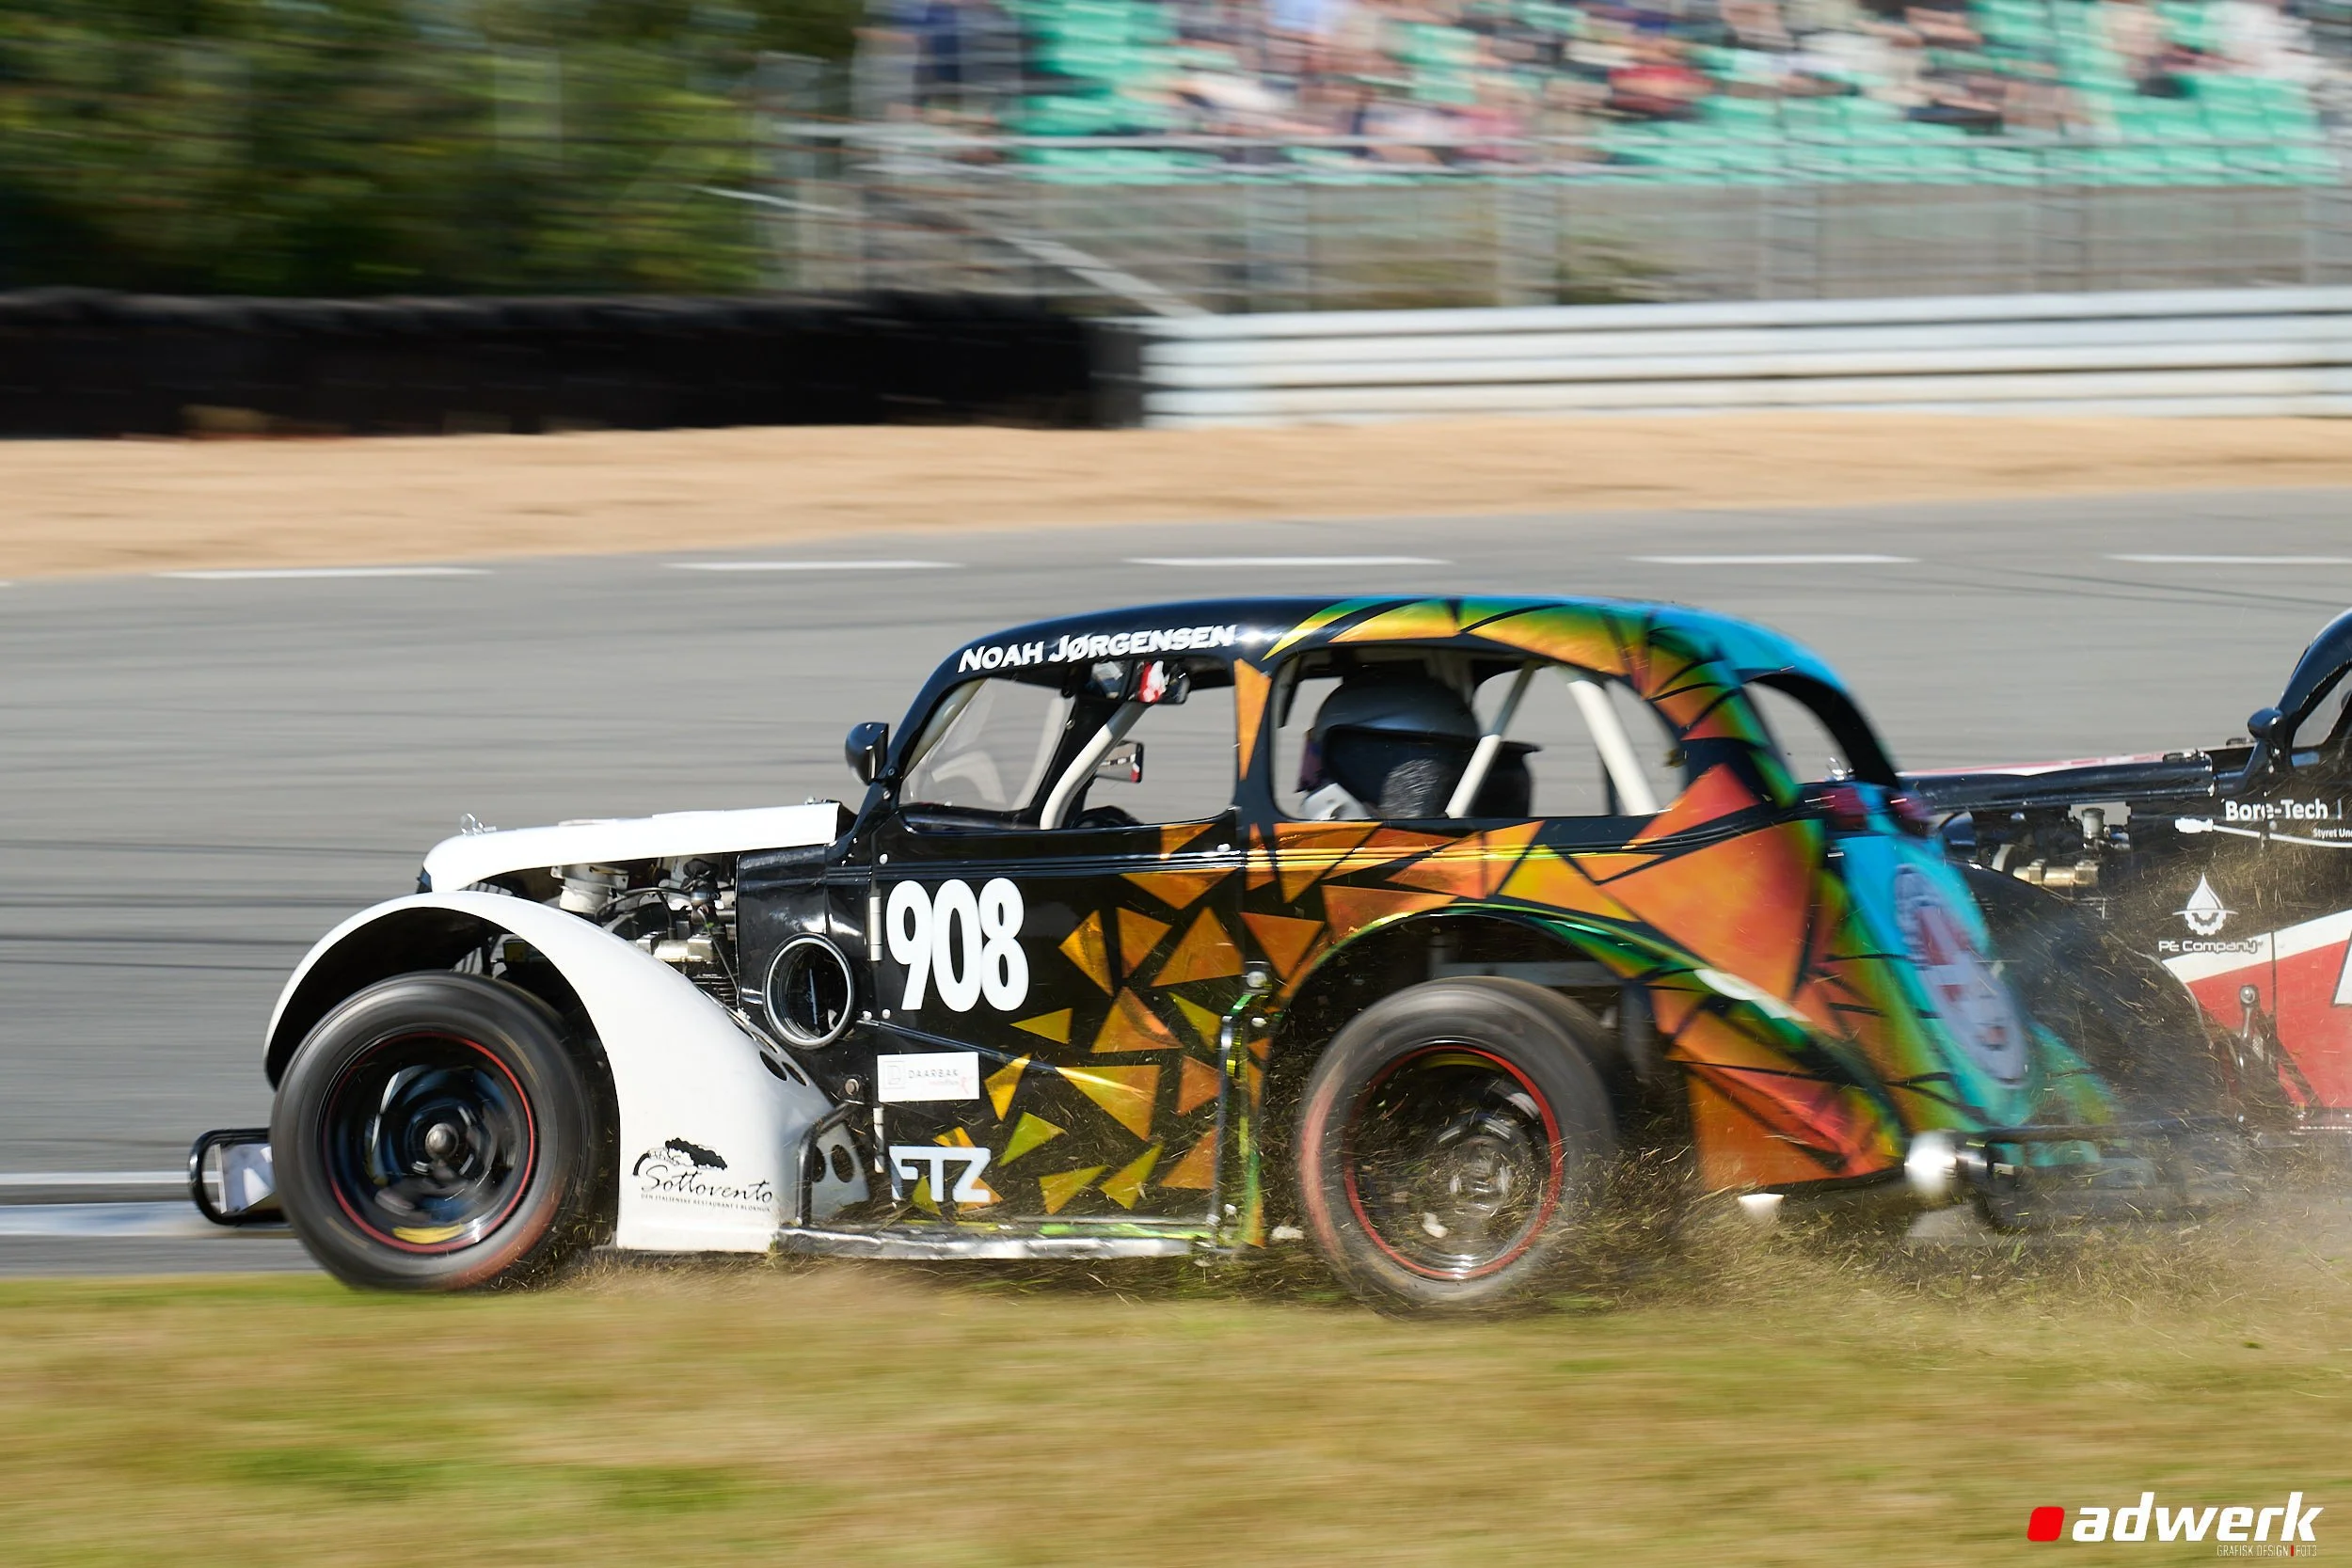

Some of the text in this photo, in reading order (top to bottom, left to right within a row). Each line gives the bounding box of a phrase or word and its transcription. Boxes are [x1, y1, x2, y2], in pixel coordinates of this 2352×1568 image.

[958, 641, 1044, 673] NOAH
[2225, 798, 2328, 821] Bore-Tech
[2312, 827, 2352, 840] Styret Un
[886, 878, 1029, 1012] 908
[2158, 940, 2258, 954] PE Company
[641, 1164, 772, 1204] Sottovento
[889, 1145, 992, 1203] FTZ
